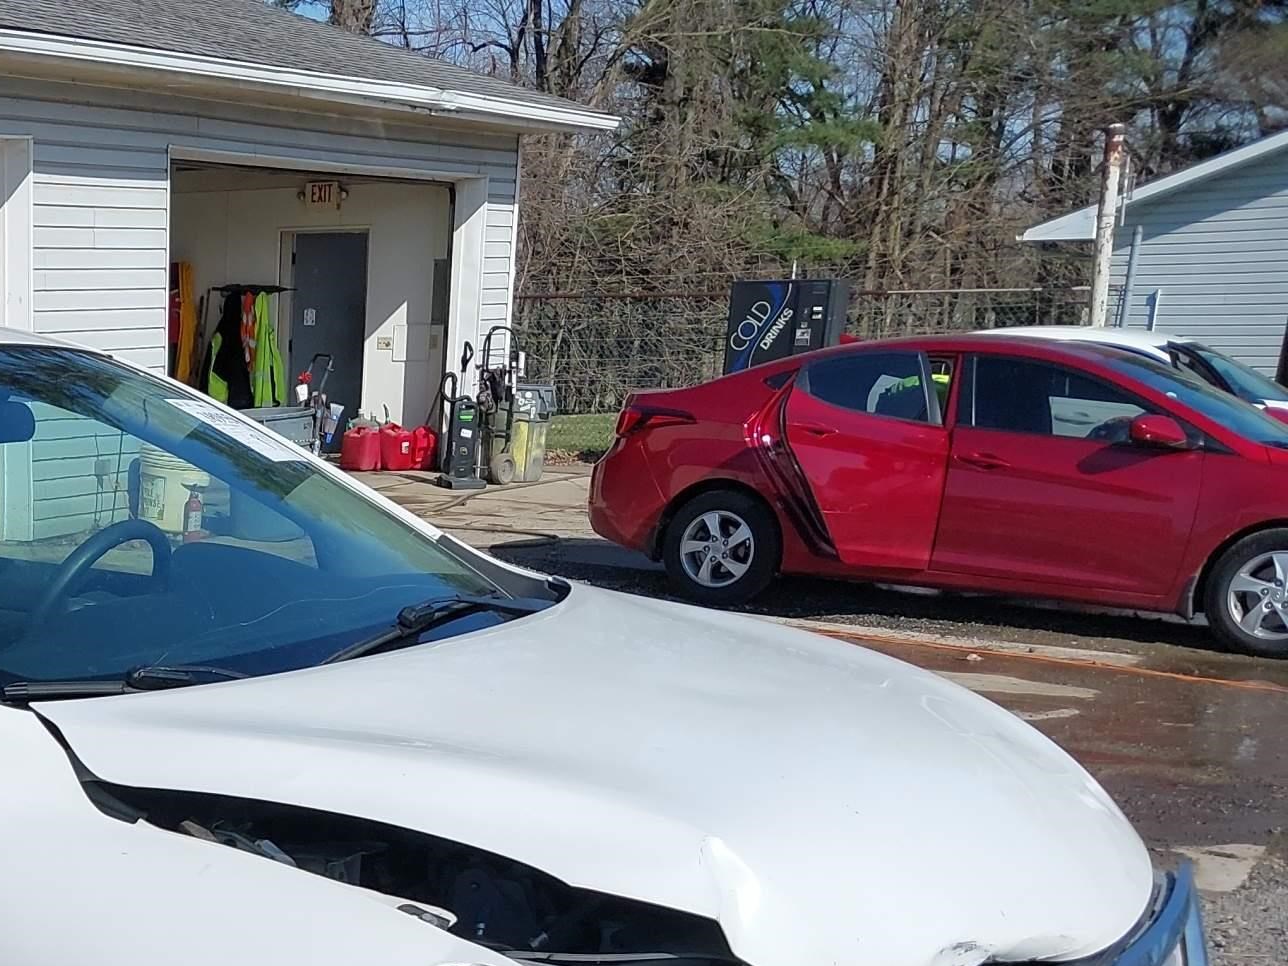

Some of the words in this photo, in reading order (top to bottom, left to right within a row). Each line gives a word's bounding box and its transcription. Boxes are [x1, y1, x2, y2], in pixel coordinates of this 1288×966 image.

[311, 183, 333, 203] EXIT
[730, 301, 771, 351] COLD
[759, 307, 794, 351] DRINKS
